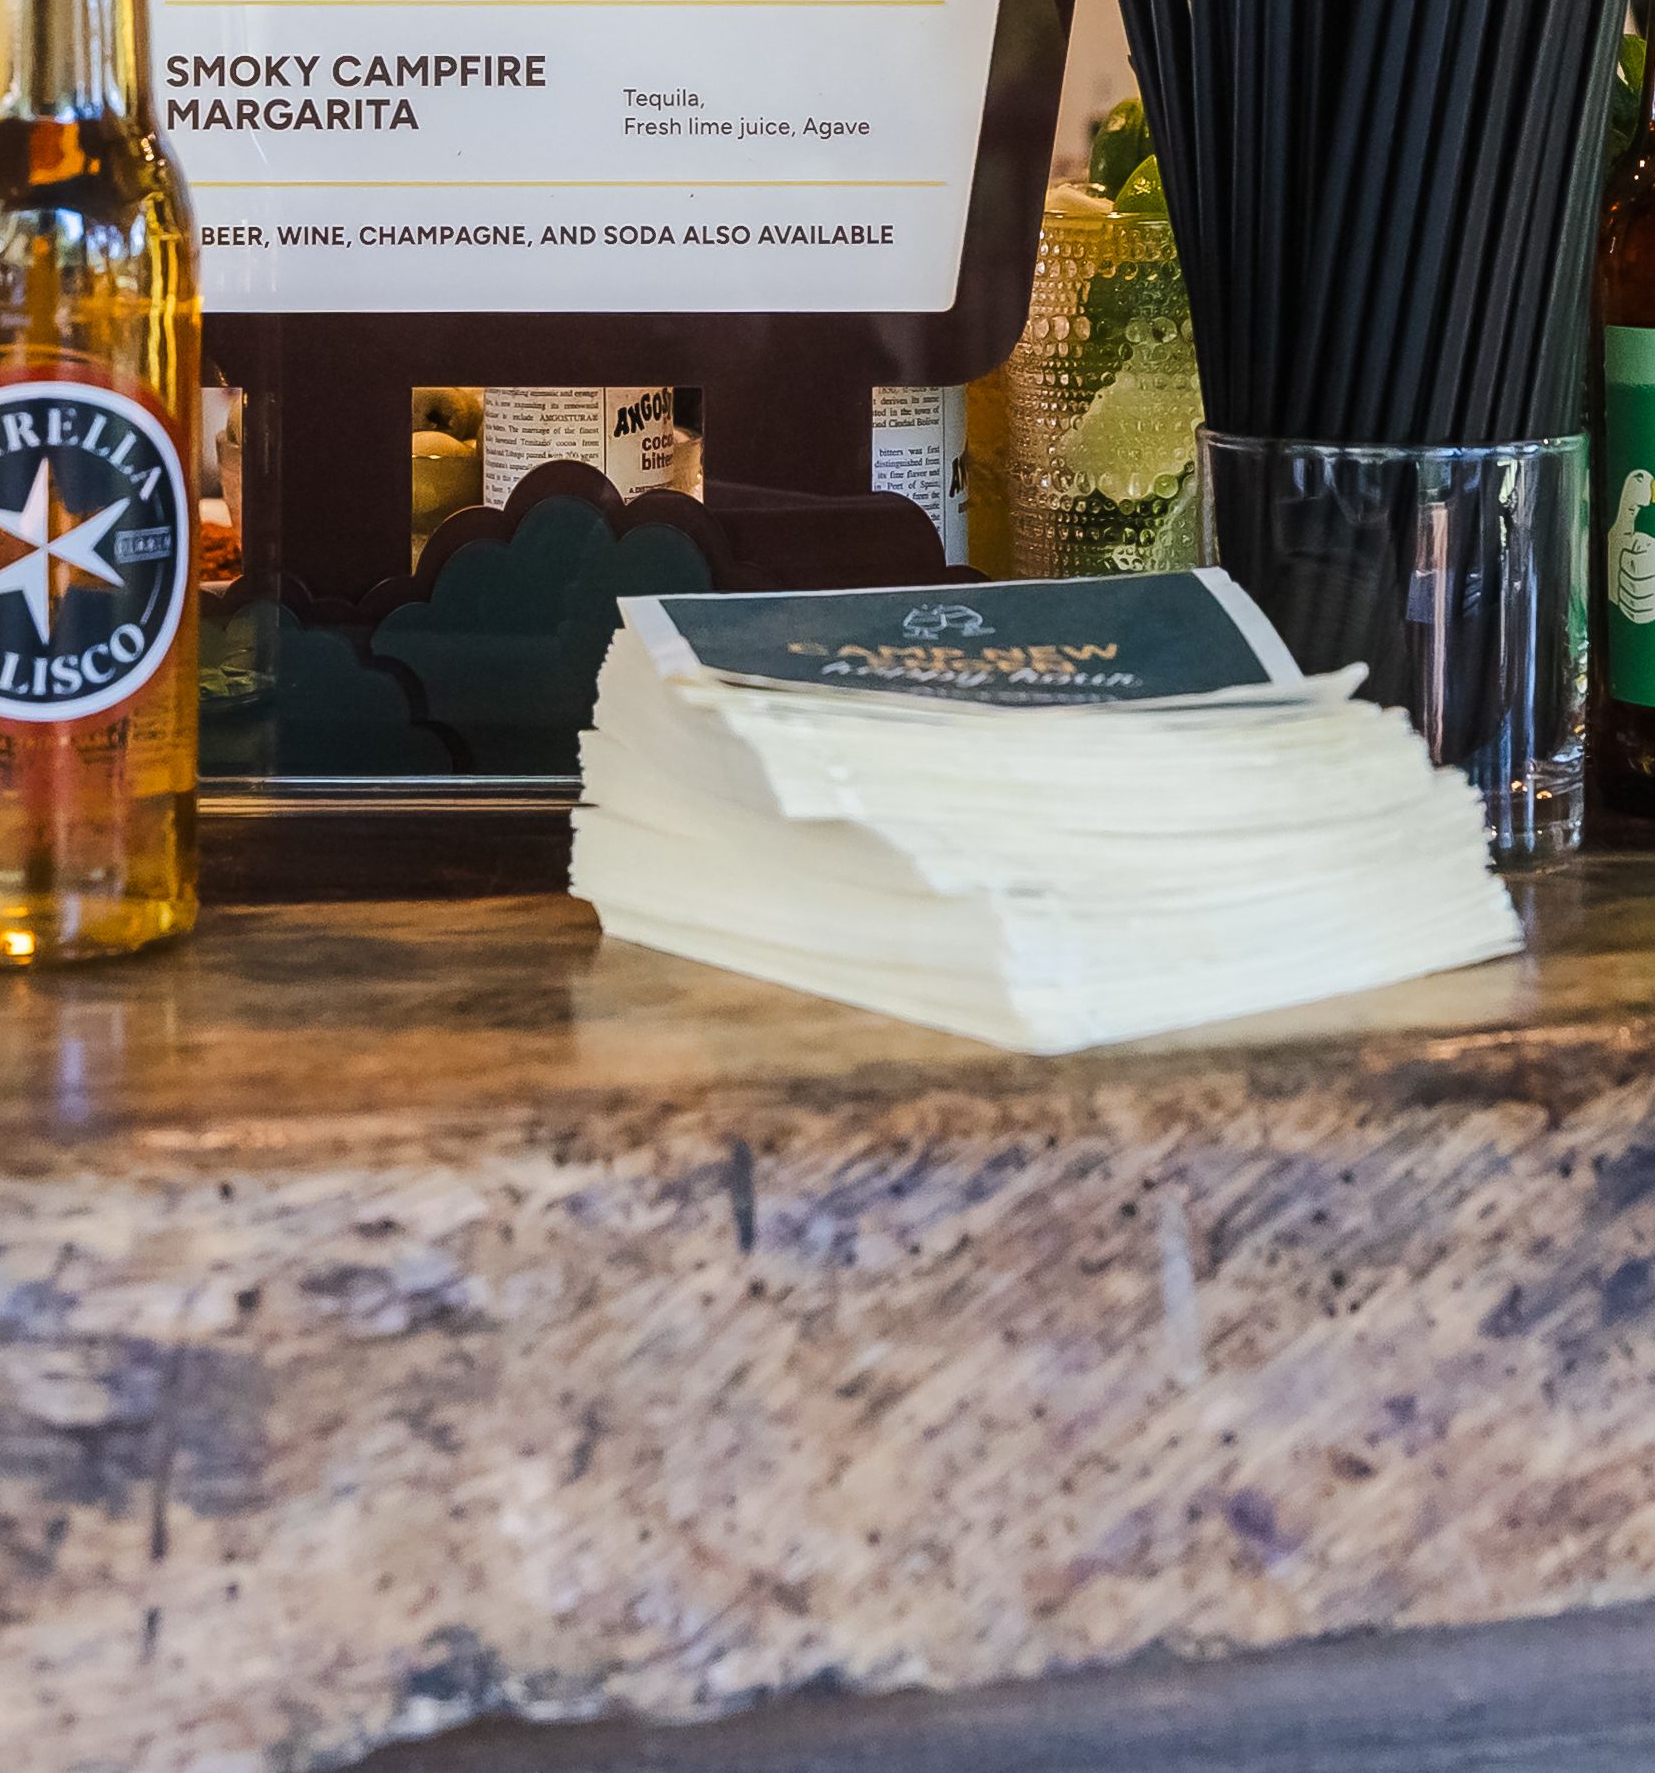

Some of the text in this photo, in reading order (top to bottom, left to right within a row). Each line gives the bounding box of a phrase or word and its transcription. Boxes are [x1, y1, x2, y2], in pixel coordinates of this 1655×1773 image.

[166, 55, 546, 88] SMOKY CAMPFIRE
[622, 88, 705, 112] Tequila,
[166, 98, 420, 131] MARGARITA
[624, 116, 871, 140] Fresh lime juice, Agave
[200, 224, 894, 249] BEER, WINE, CHAMPAGNE, AND SODA ALSO AVAILABLE
